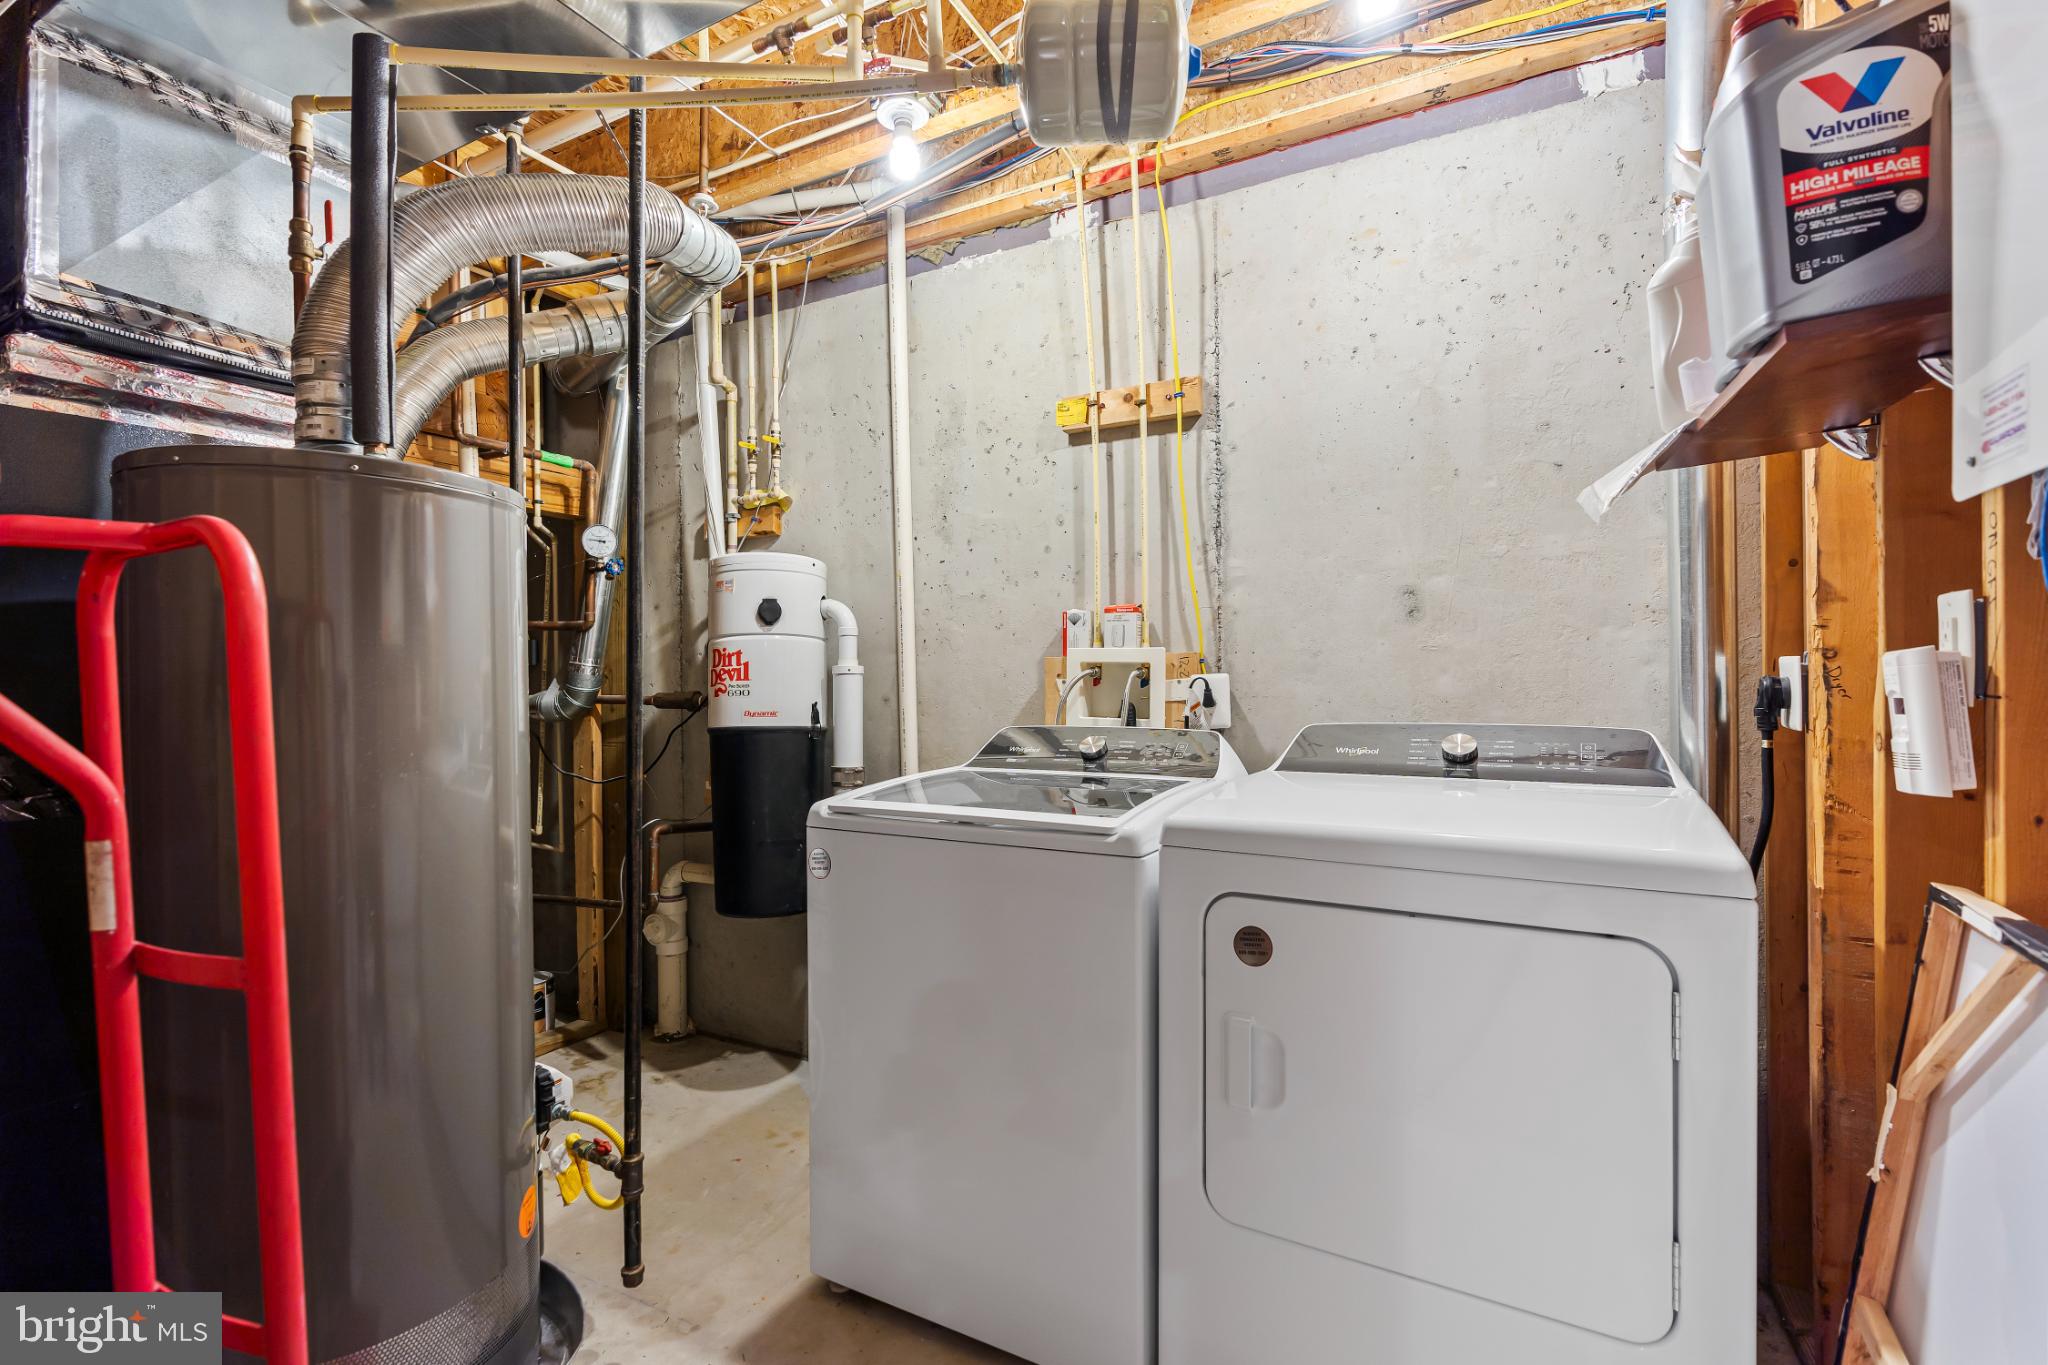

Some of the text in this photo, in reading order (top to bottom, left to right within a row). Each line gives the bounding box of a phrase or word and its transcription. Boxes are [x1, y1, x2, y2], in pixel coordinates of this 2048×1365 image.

[1805, 109, 1910, 141] Valvoline
[1823, 147, 1897, 168] FULL SYNTHETIC
[1790, 155, 1922, 195] HIGH MILEAGE
[712, 648, 742, 669] Dirt
[710, 661, 750, 687] Devil
[727, 689, 750, 697] 690
[1335, 747, 1379, 755] Whirlpool
